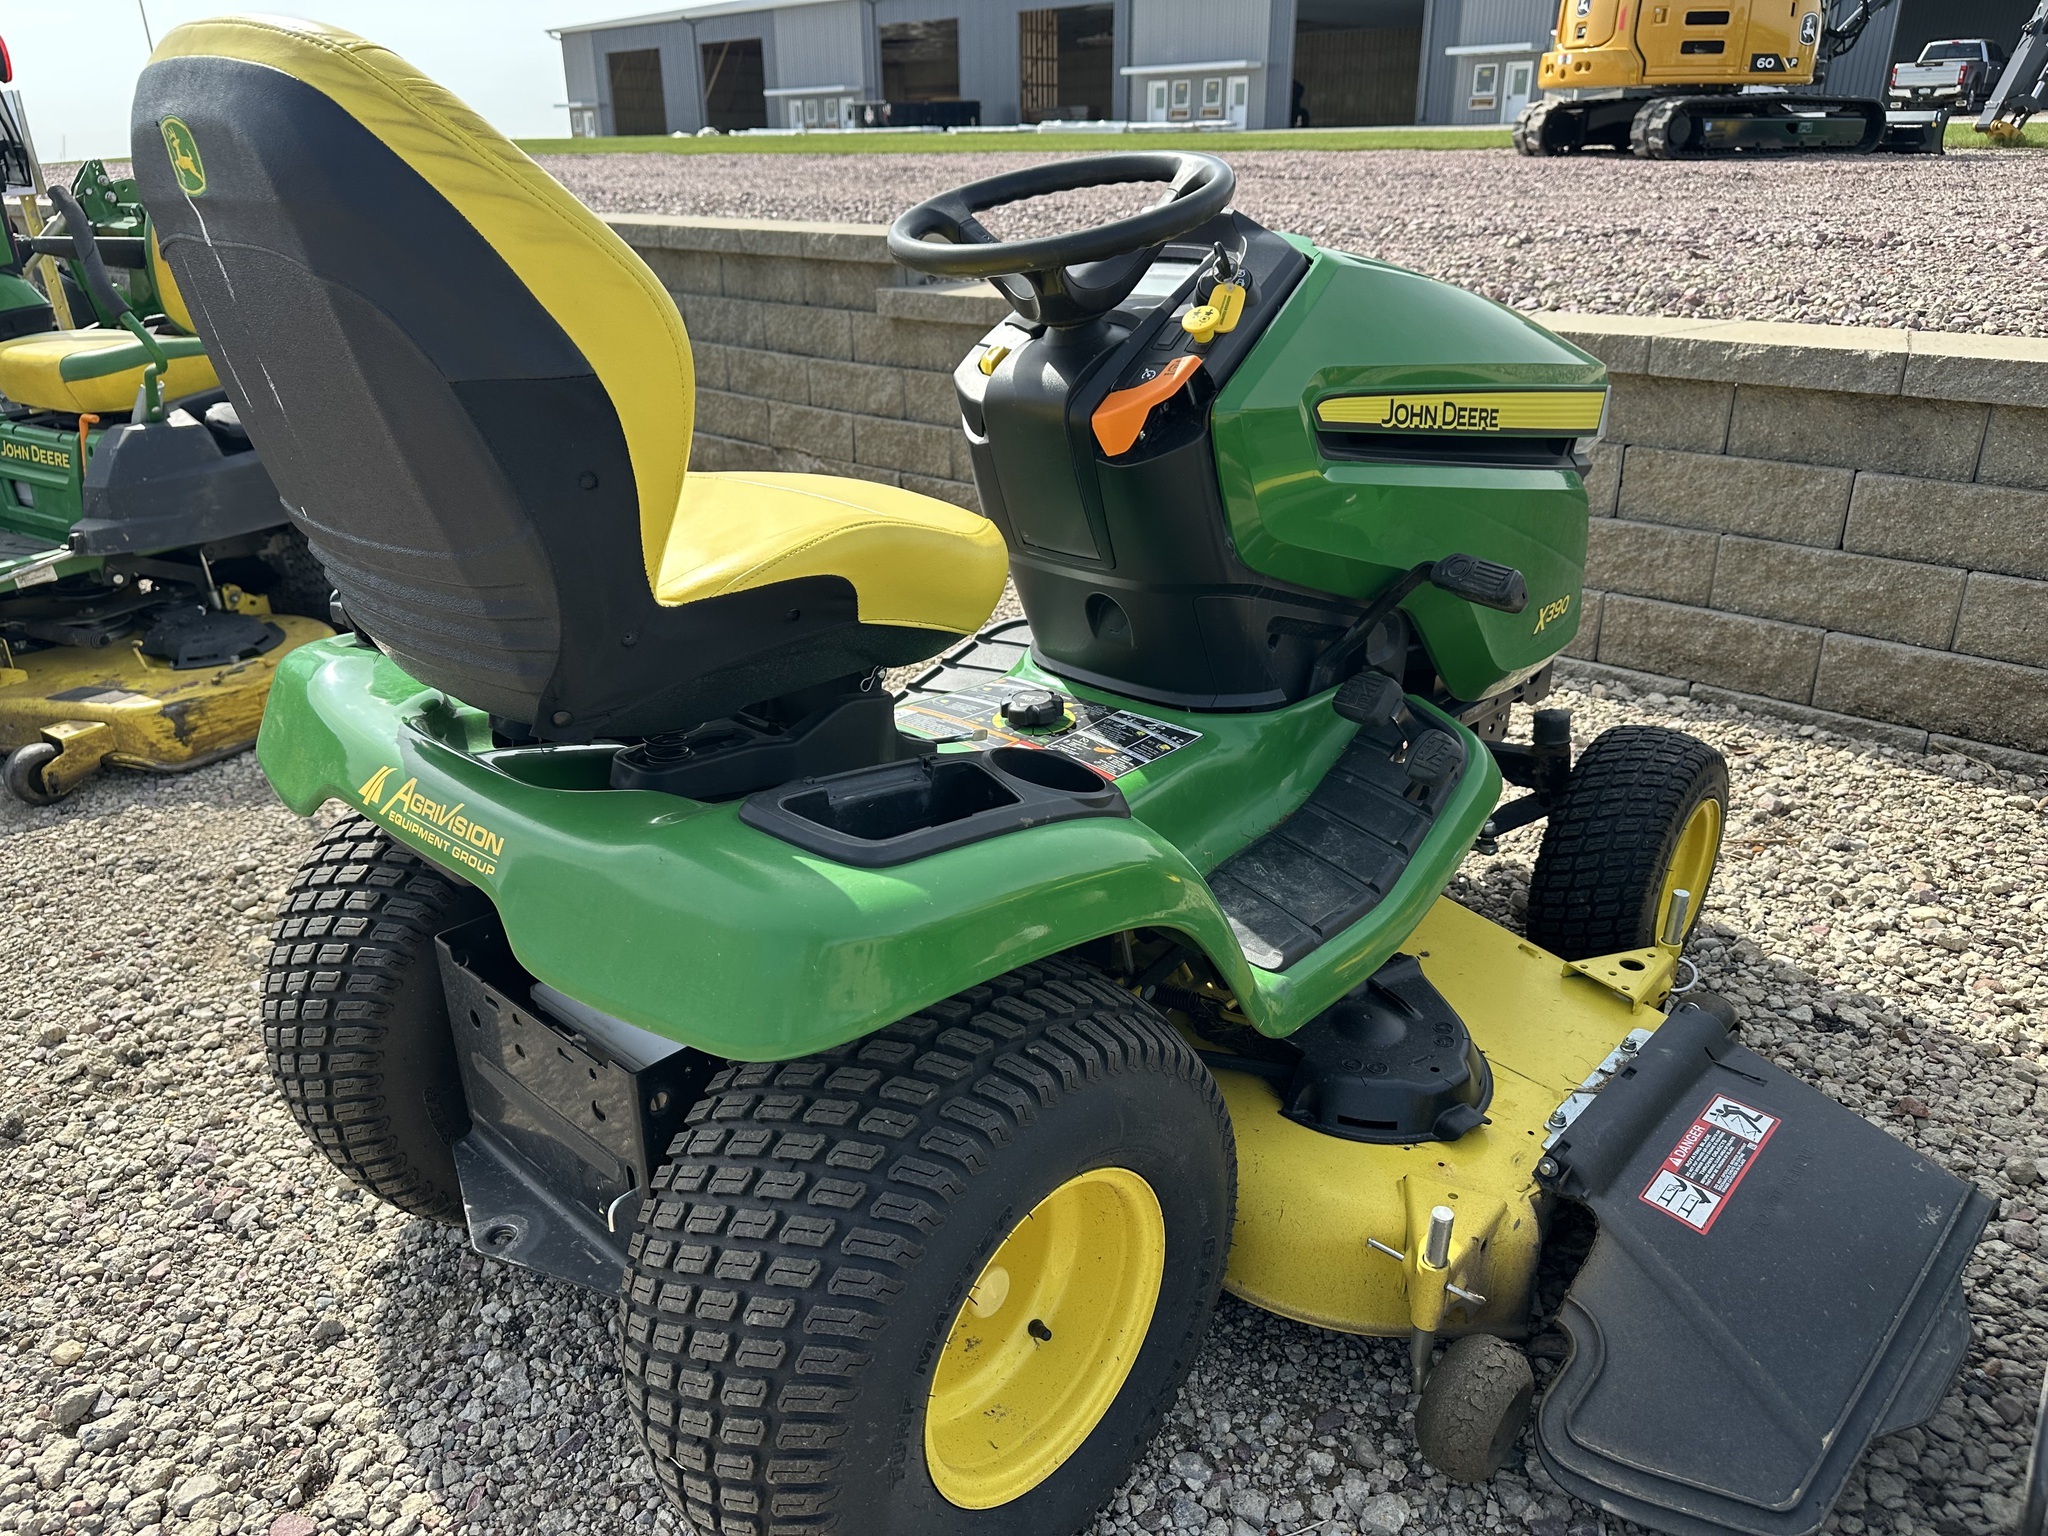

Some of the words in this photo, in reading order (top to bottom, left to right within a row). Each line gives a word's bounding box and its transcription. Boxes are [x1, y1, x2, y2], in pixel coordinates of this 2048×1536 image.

[1756, 57, 1775, 69] 60
[1382, 398, 1438, 427] JOHN
[1442, 401, 1500, 428] DEERE
[0, 439, 30, 460] JOHN
[31, 444, 71, 469] DEERE
[1533, 594, 1571, 636] X390
[388, 810, 451, 852] EQUIPMENT
[451, 846, 496, 876] GROUP
[1674, 1124, 1706, 1159] DANGER
